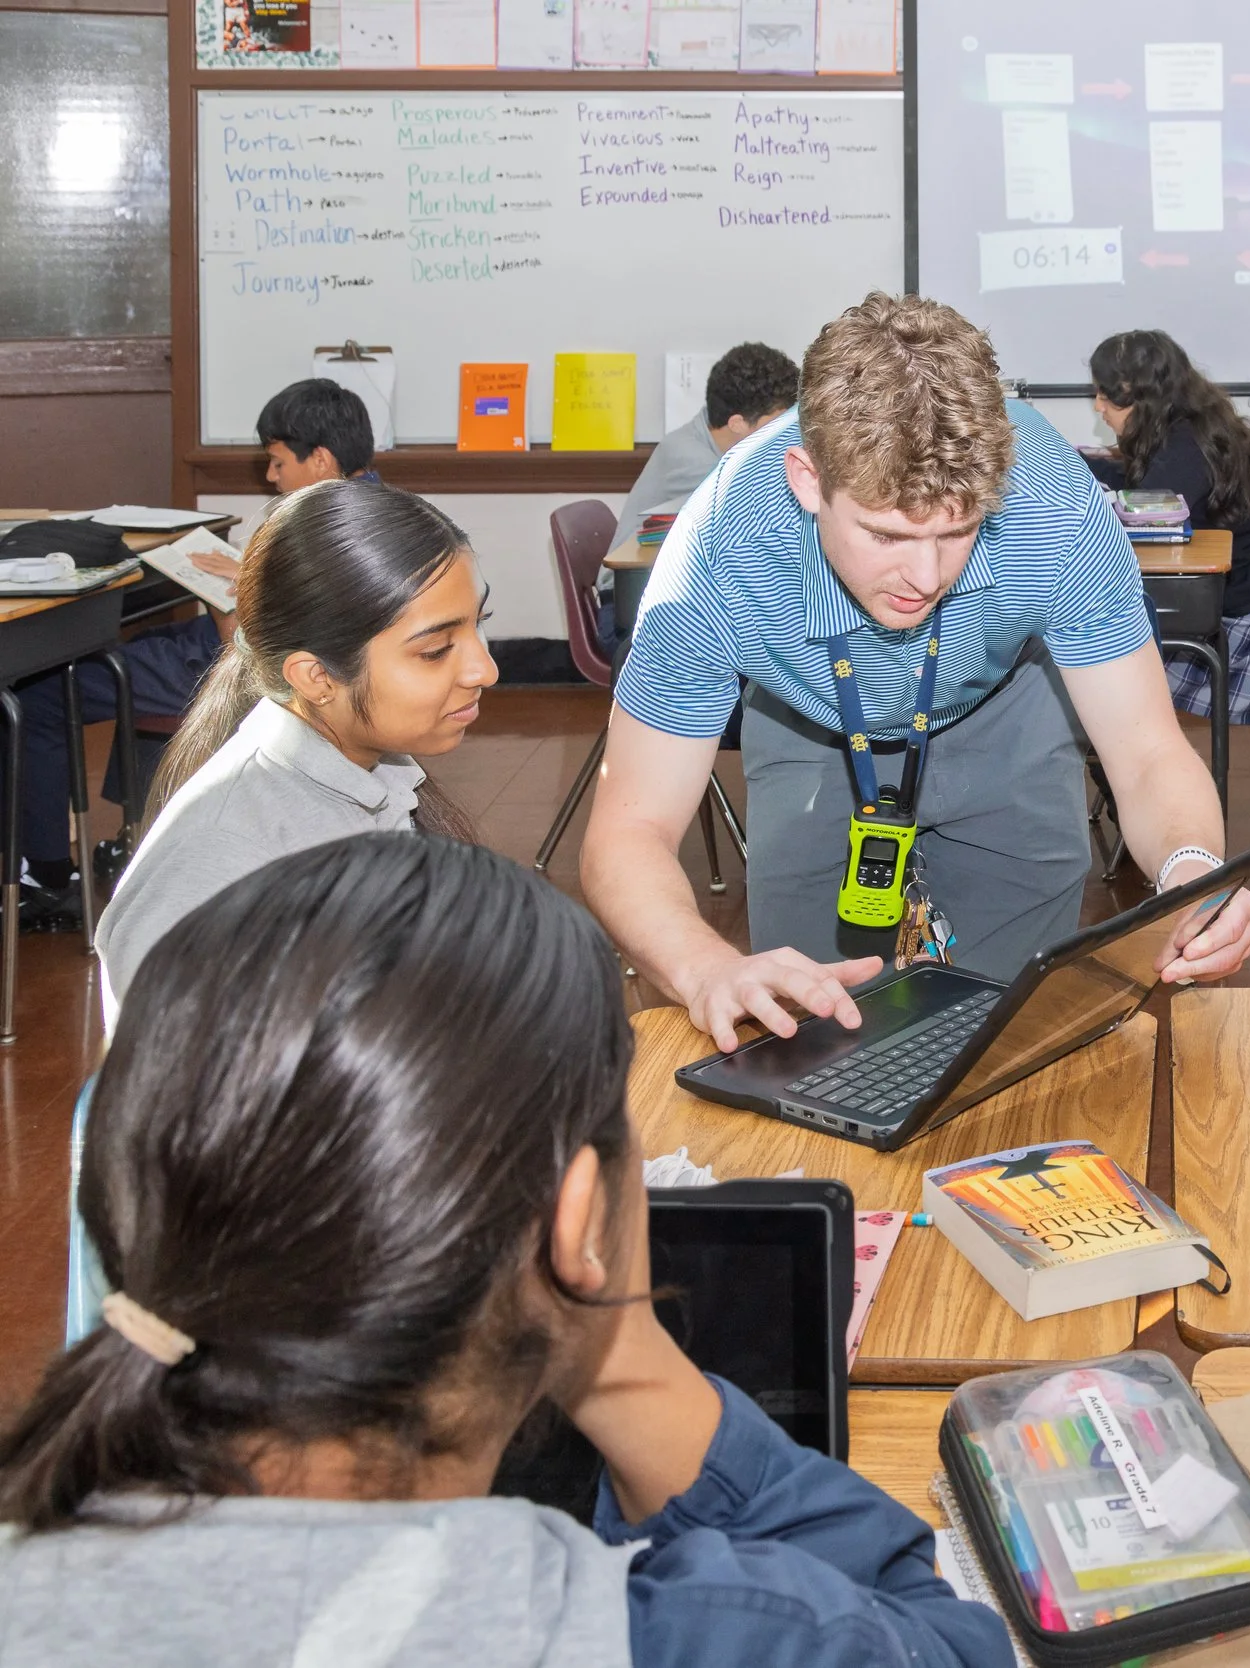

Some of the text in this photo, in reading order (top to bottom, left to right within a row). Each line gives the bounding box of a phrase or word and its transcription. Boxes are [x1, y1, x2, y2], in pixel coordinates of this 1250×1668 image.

[392, 99, 498, 123] Prosperous
[577, 101, 669, 122] Preeminent
[735, 101, 809, 134] Apathy
[223, 126, 303, 154] Portal
[397, 127, 496, 145] Maladies
[580, 130, 664, 147] Vivacious
[734, 132, 830, 163] Maltreating
[225, 161, 331, 183] Wormhole
[407, 162, 491, 187] Puzzled
[578, 154, 668, 176] Inventive
[734, 162, 783, 190] Reign
[236, 188, 301, 213] Path
[409, 189, 497, 216] Moribund
[580, 185, 668, 207] Expounded
[718, 204, 831, 228] Disheartened
[255, 218, 357, 250] Destination
[407, 224, 491, 251] Stricken
[410, 252, 494, 283] Deserted
[1013, 244, 1091, 270] 06:14
[232, 261, 320, 306] Journey
[1008, 1201, 1145, 1236] ARTHUR
[1040, 1214, 1158, 1251] KING
[1088, 1395, 1115, 1437] Adeline
[1112, 1439, 1123, 1453] R.
[1125, 1462, 1148, 1503] Grade
[1146, 1506, 1157, 1514] 7
[1090, 1516, 1112, 1530] 10
